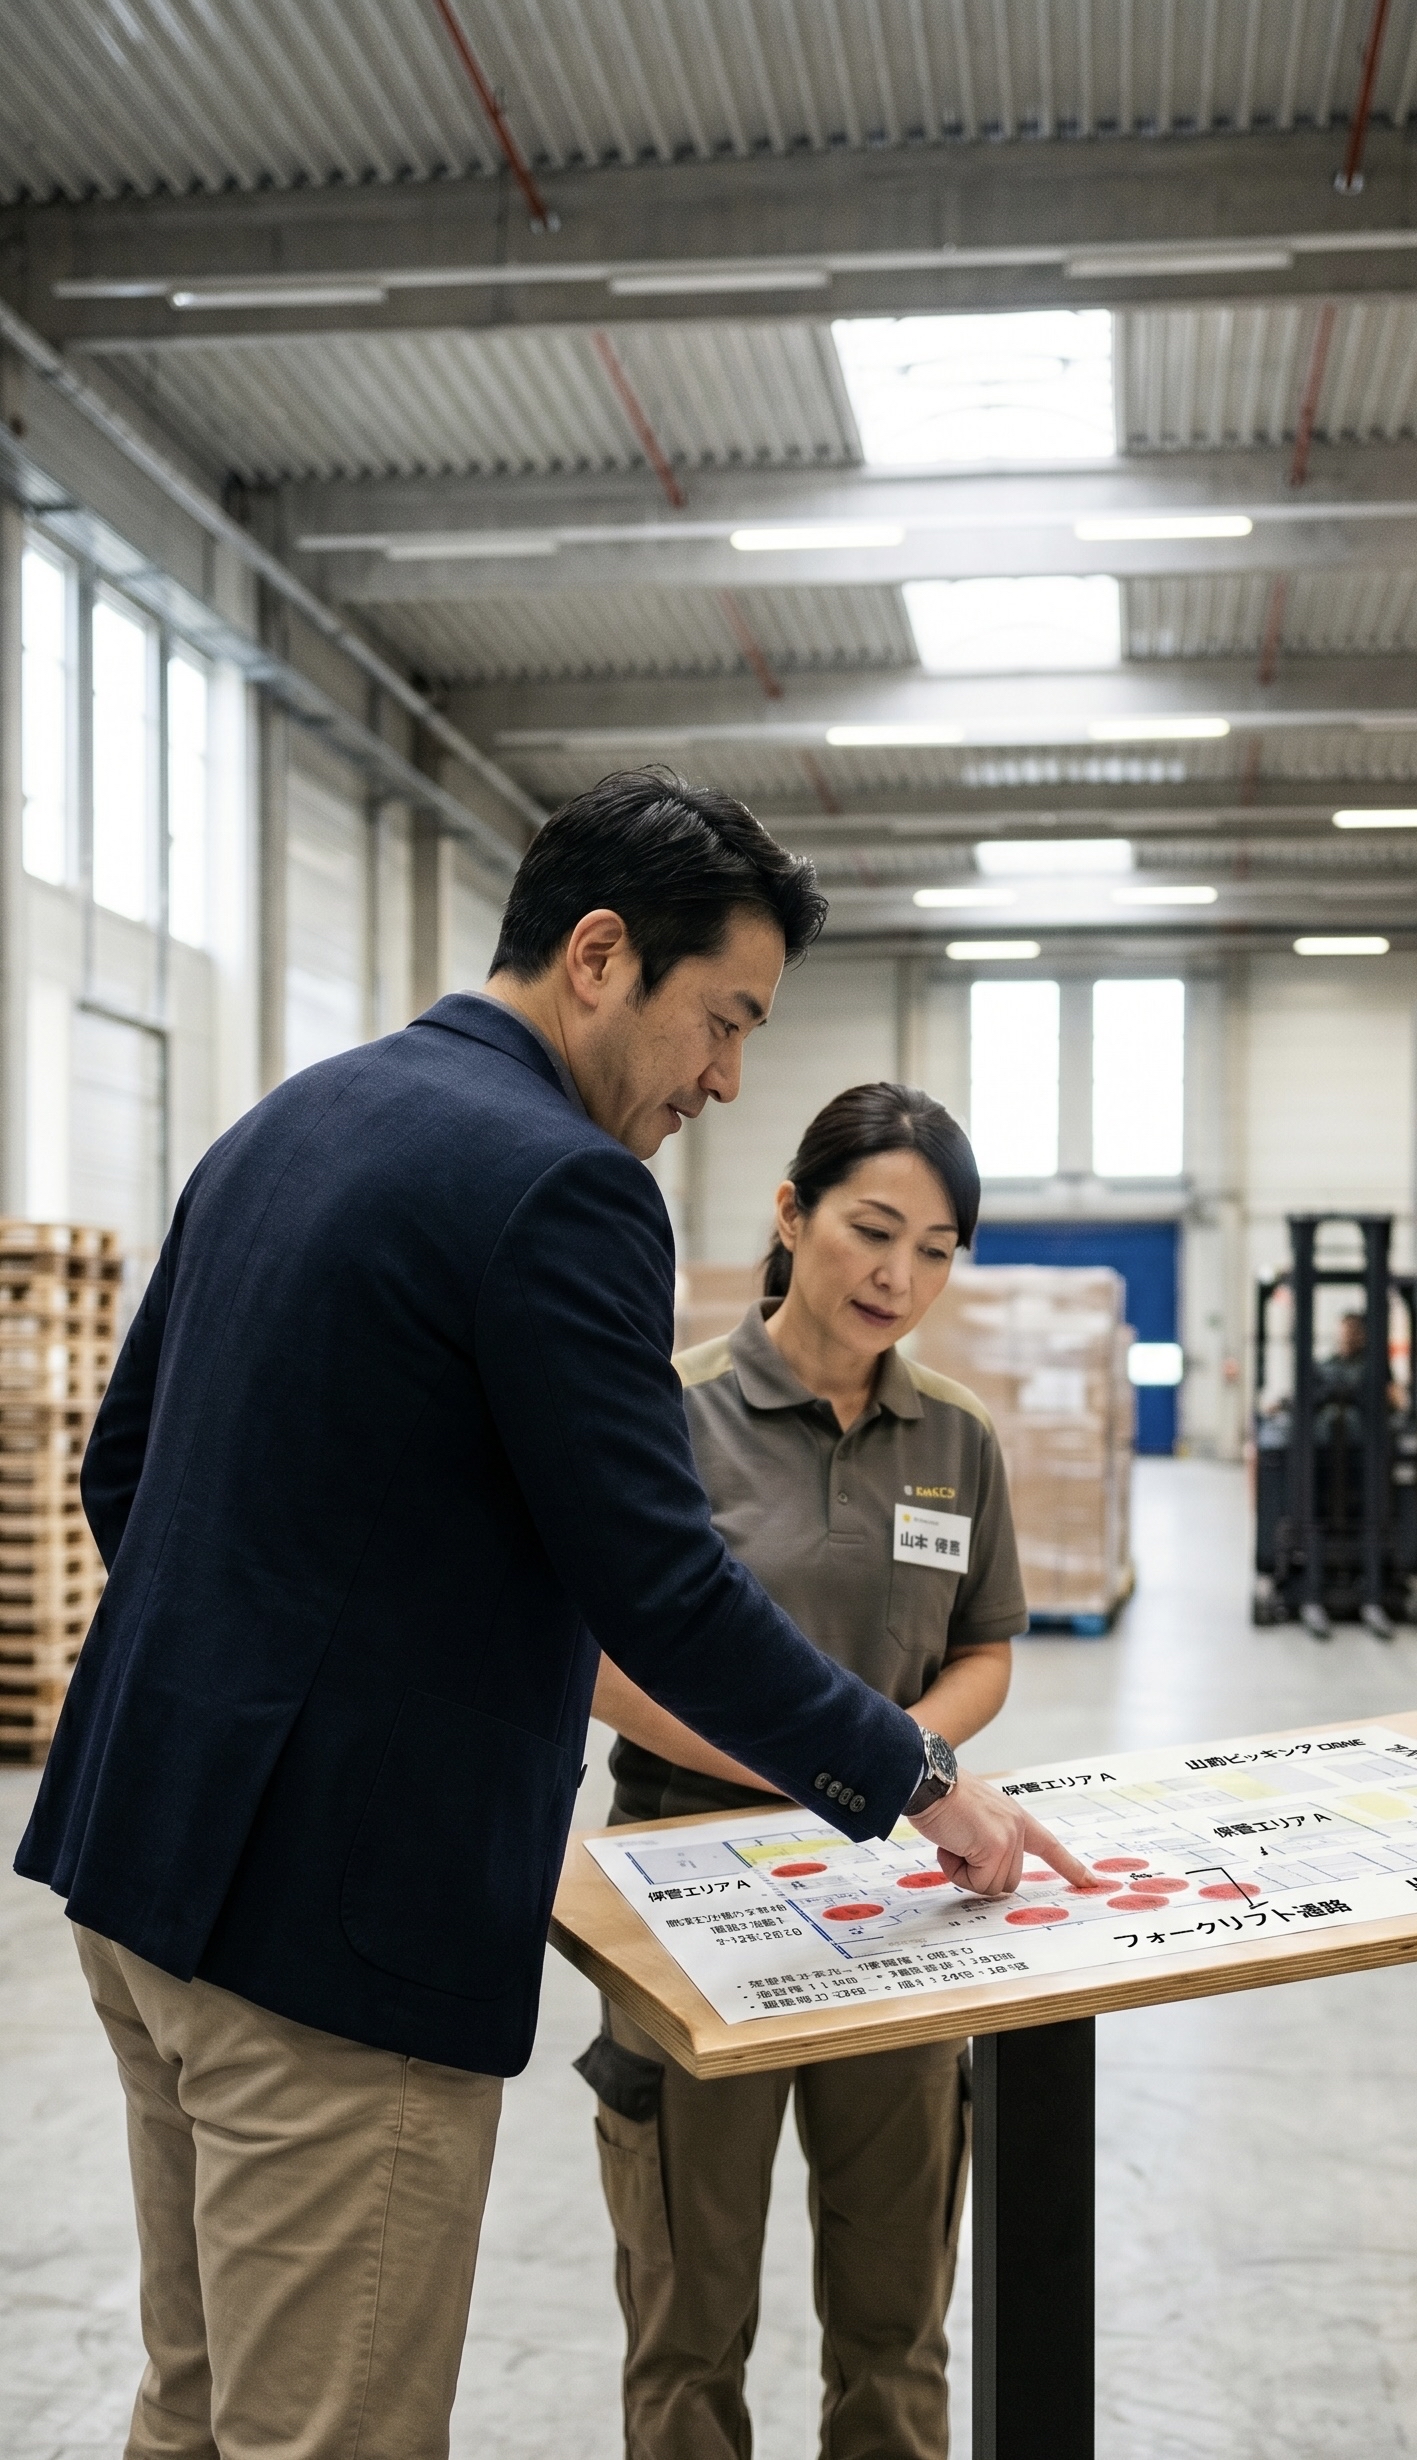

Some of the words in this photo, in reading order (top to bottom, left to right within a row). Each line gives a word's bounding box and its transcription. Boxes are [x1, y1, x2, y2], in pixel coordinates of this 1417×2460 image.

[900, 1531, 928, 1550] 山本
[1002, 1775, 1092, 1797] 保管エリア
[1100, 1772, 1117, 1783] A
[1213, 1815, 1306, 1839] 保管エリア
[1313, 1813, 1333, 1823] A
[737, 1879, 751, 1890] A
